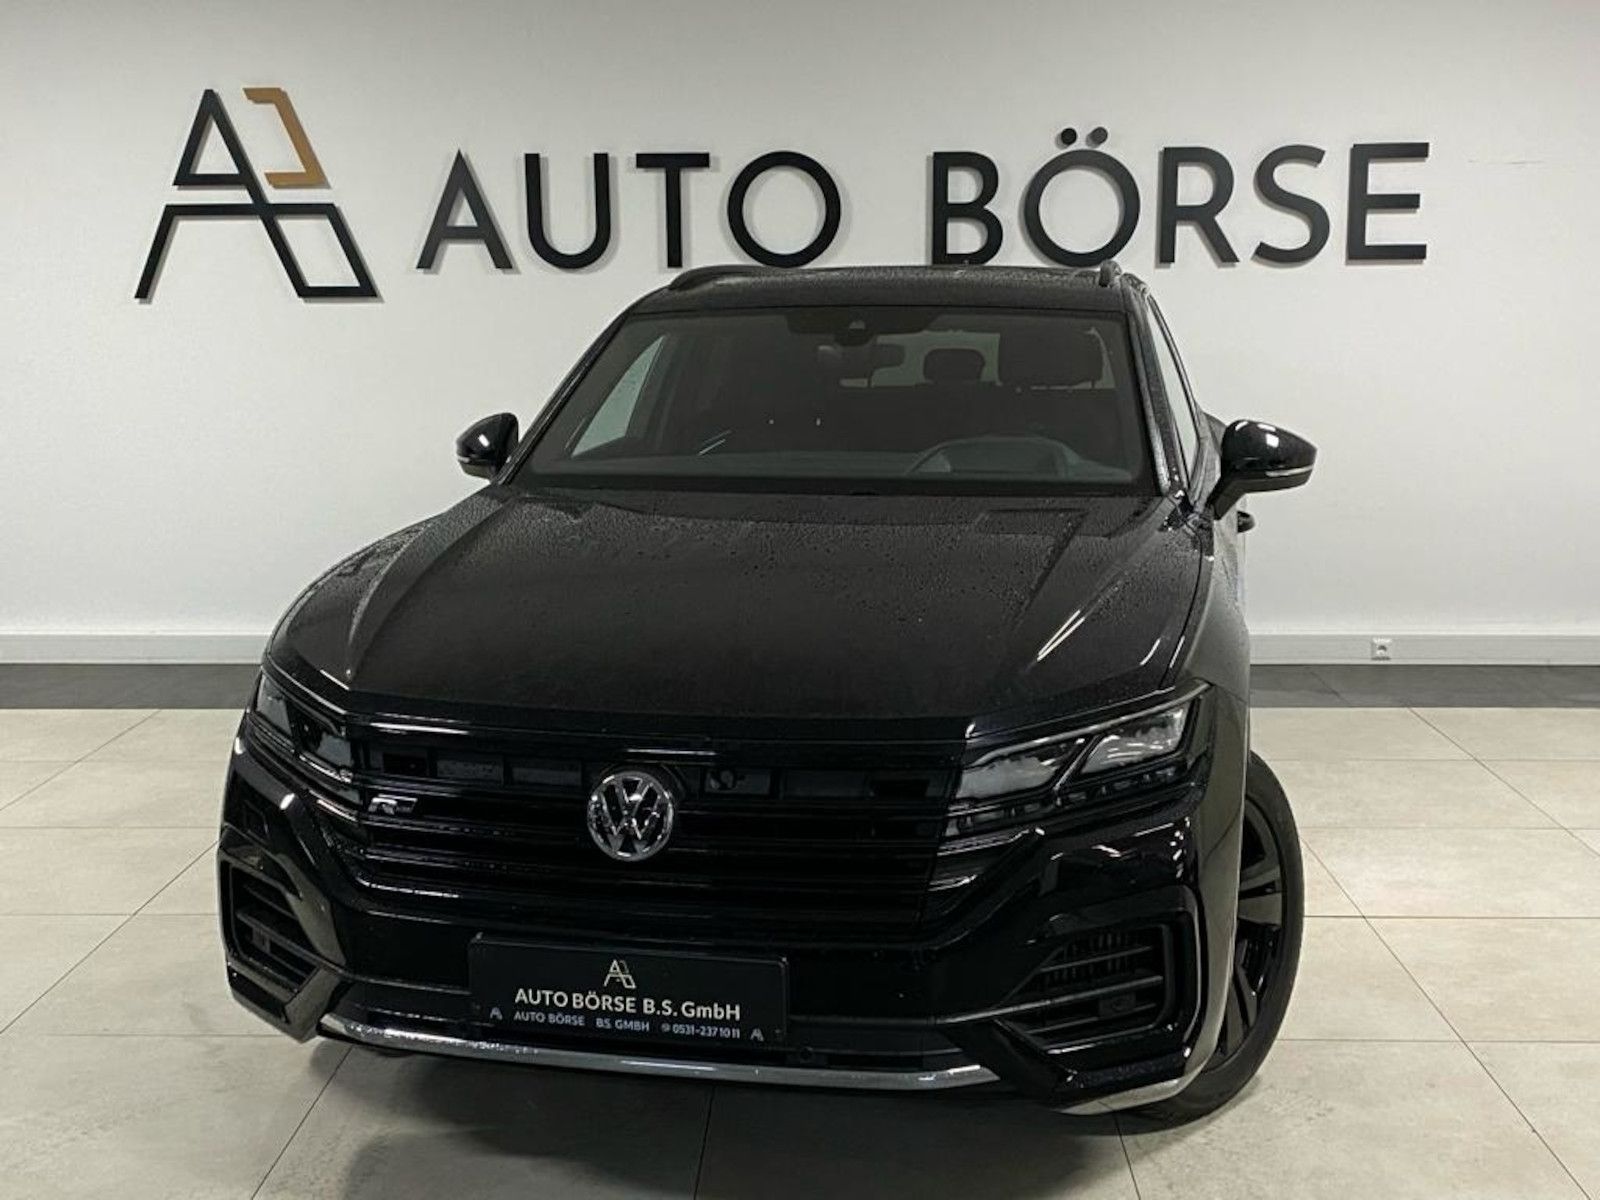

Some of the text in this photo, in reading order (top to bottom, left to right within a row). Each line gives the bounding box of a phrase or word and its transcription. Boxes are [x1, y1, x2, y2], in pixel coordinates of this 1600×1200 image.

[416, 127, 1430, 269] AUTO BÖRSE
[513, 1010, 546, 1024] AUTO
[547, 1012, 586, 1027] BÖRSE
[614, 1018, 650, 1032] GMBH
[514, 988, 741, 1021] AUTO BÖRSE B.S. GmbH
